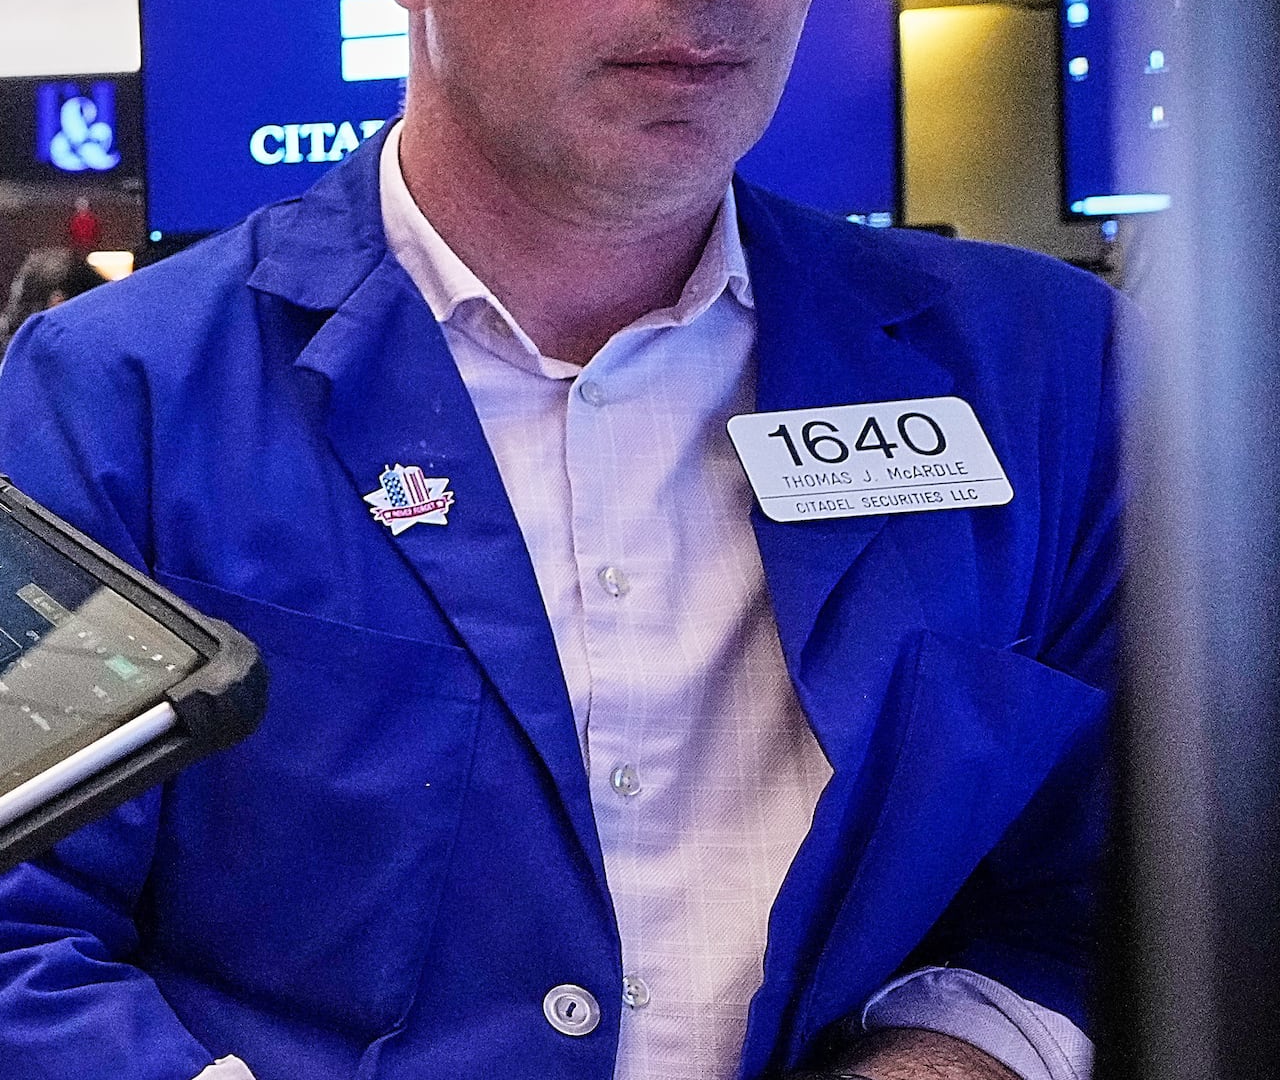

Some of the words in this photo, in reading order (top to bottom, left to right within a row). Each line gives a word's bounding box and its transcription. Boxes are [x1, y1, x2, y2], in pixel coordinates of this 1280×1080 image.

[249, 120, 384, 165] CITA
[768, 412, 947, 466] 1640
[782, 471, 852, 489] THOMAS
[863, 469, 878, 483] J.
[887, 461, 969, 481] McARDLE
[796, 498, 855, 514] CITADEL
[862, 491, 943, 509] SECURITIES
[951, 487, 979, 501] LLC
